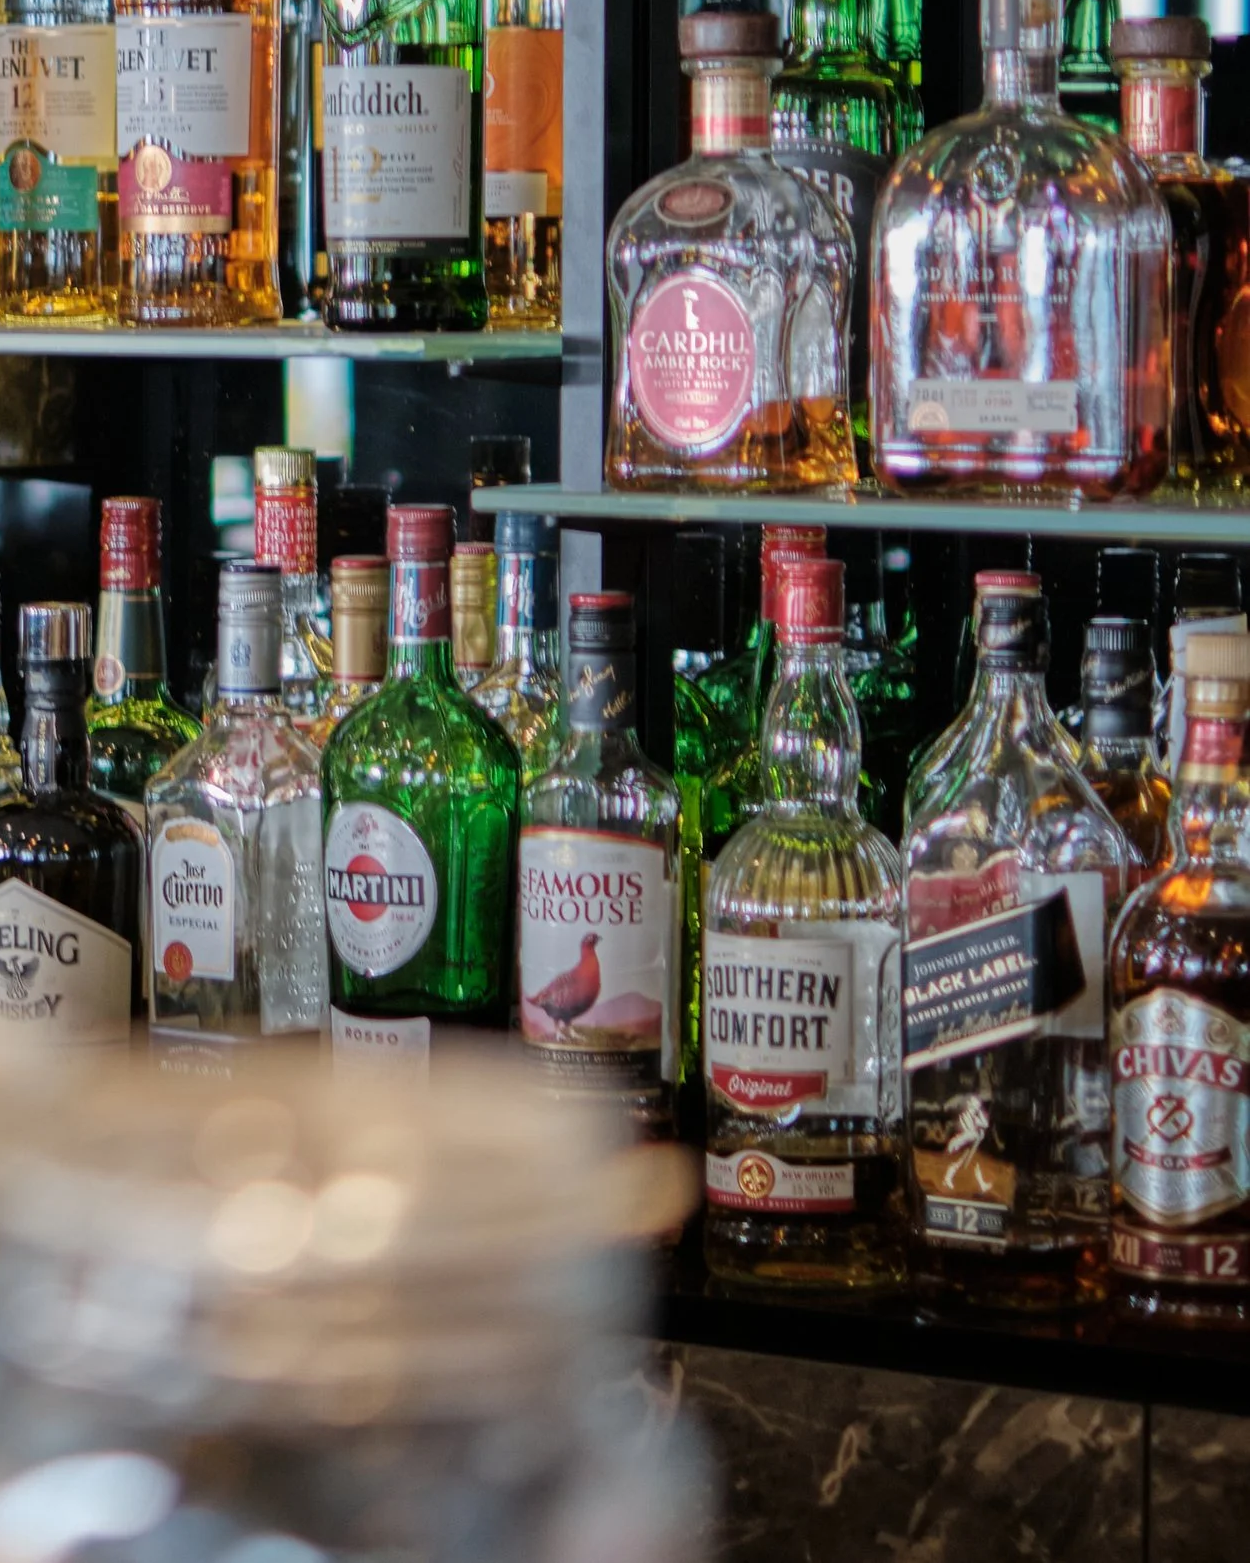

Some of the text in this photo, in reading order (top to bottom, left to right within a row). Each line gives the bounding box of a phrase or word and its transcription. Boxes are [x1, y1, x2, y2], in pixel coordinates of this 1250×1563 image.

[393, 123, 440, 135] WHISKY
[162, 203, 212, 216] RESERVE
[643, 353, 742, 372] AMBER ROCK
[162, 870, 224, 910] Cuervo
[329, 868, 422, 907] MARTINI
[526, 864, 644, 901] FAMOUS
[167, 914, 220, 932] ESPECIAL
[525, 894, 644, 926] GROUSE
[913, 952, 965, 982] JOHNNIE
[706, 962, 842, 1010] SOUTHERN
[904, 971, 967, 1007] BLACK
[907, 976, 1030, 1026] BLENDED SCOTCH WHISKY
[344, 1025, 399, 1047] ROSSO
[1117, 1046, 1244, 1088] CHIVAS
[728, 1071, 793, 1100] Original
[955, 1205, 980, 1235] 12
[1203, 1245, 1240, 1276] 12
